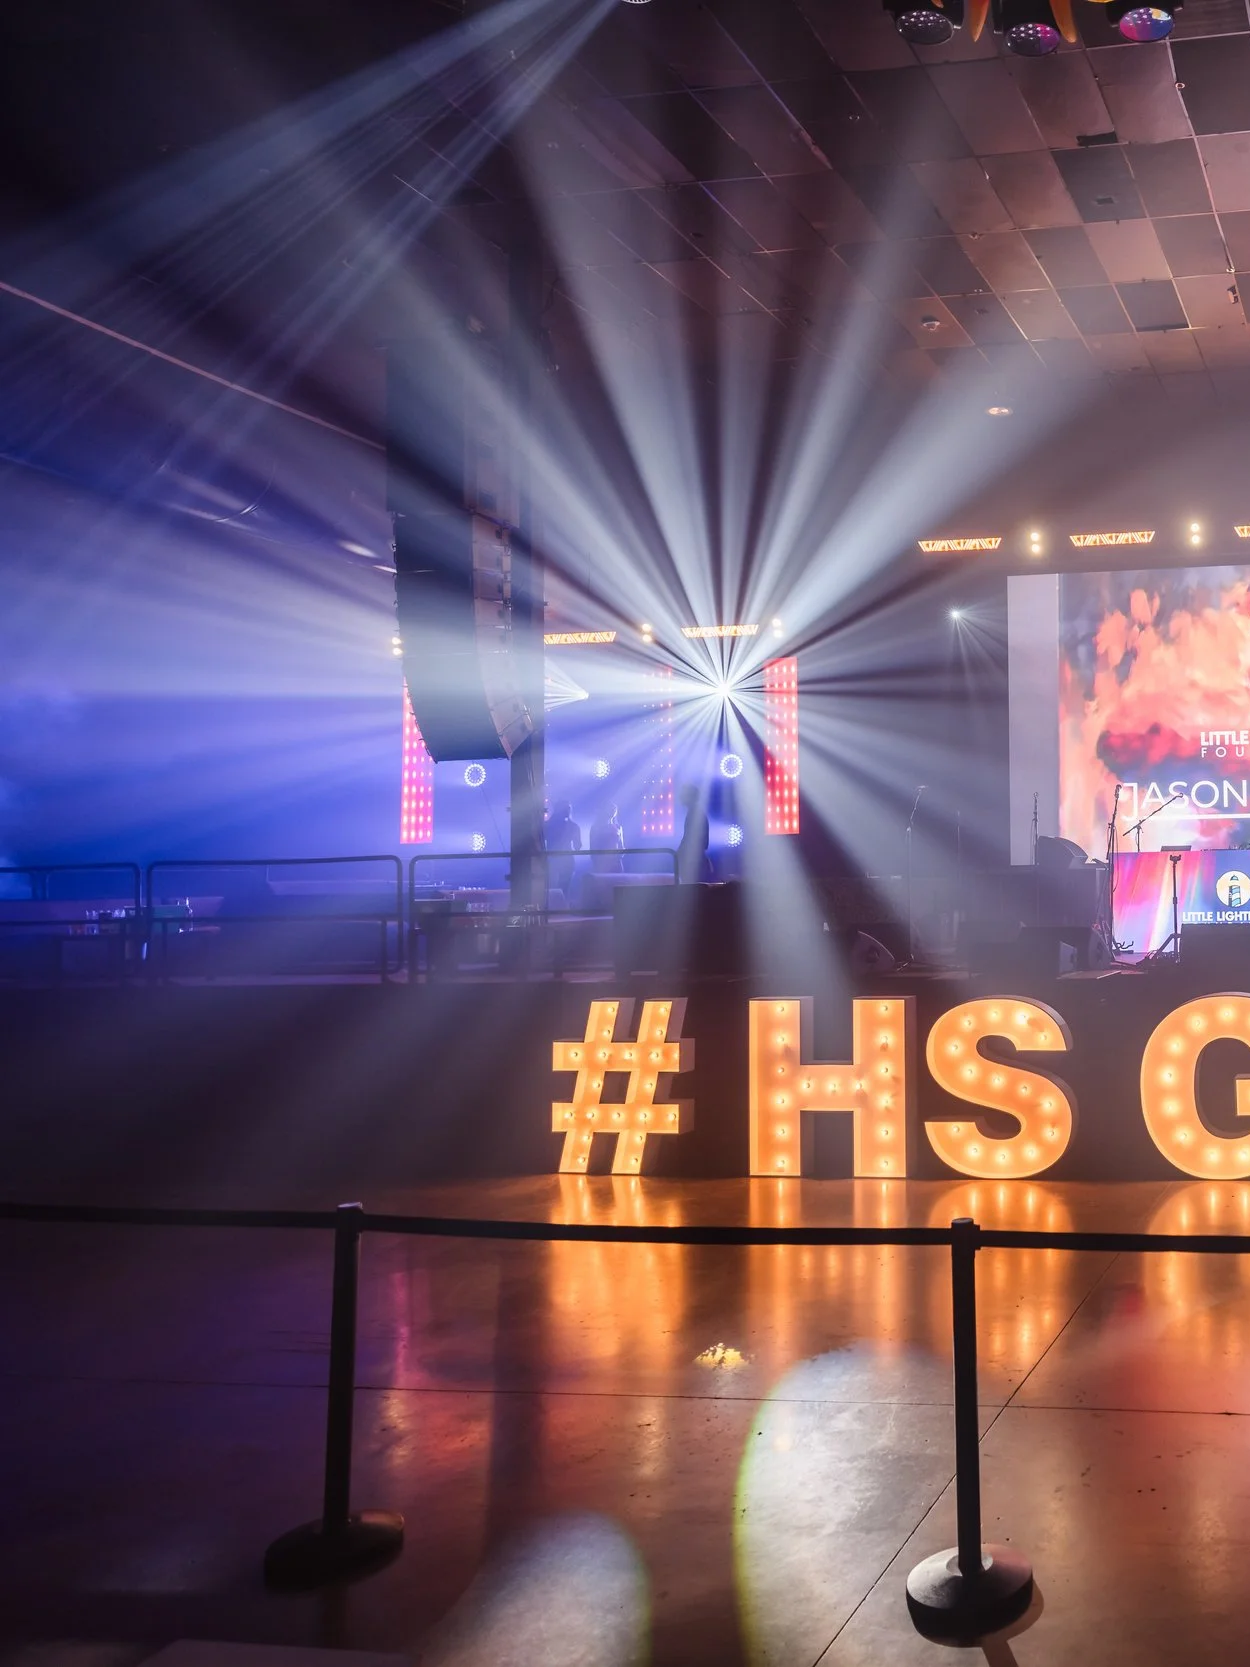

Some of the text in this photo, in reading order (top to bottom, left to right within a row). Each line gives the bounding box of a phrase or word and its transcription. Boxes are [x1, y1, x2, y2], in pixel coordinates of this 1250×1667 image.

[1201, 730, 1249, 746] LITTLE
[1122, 779, 1248, 821] JASON
[1182, 911, 1213, 921] LITTLE
